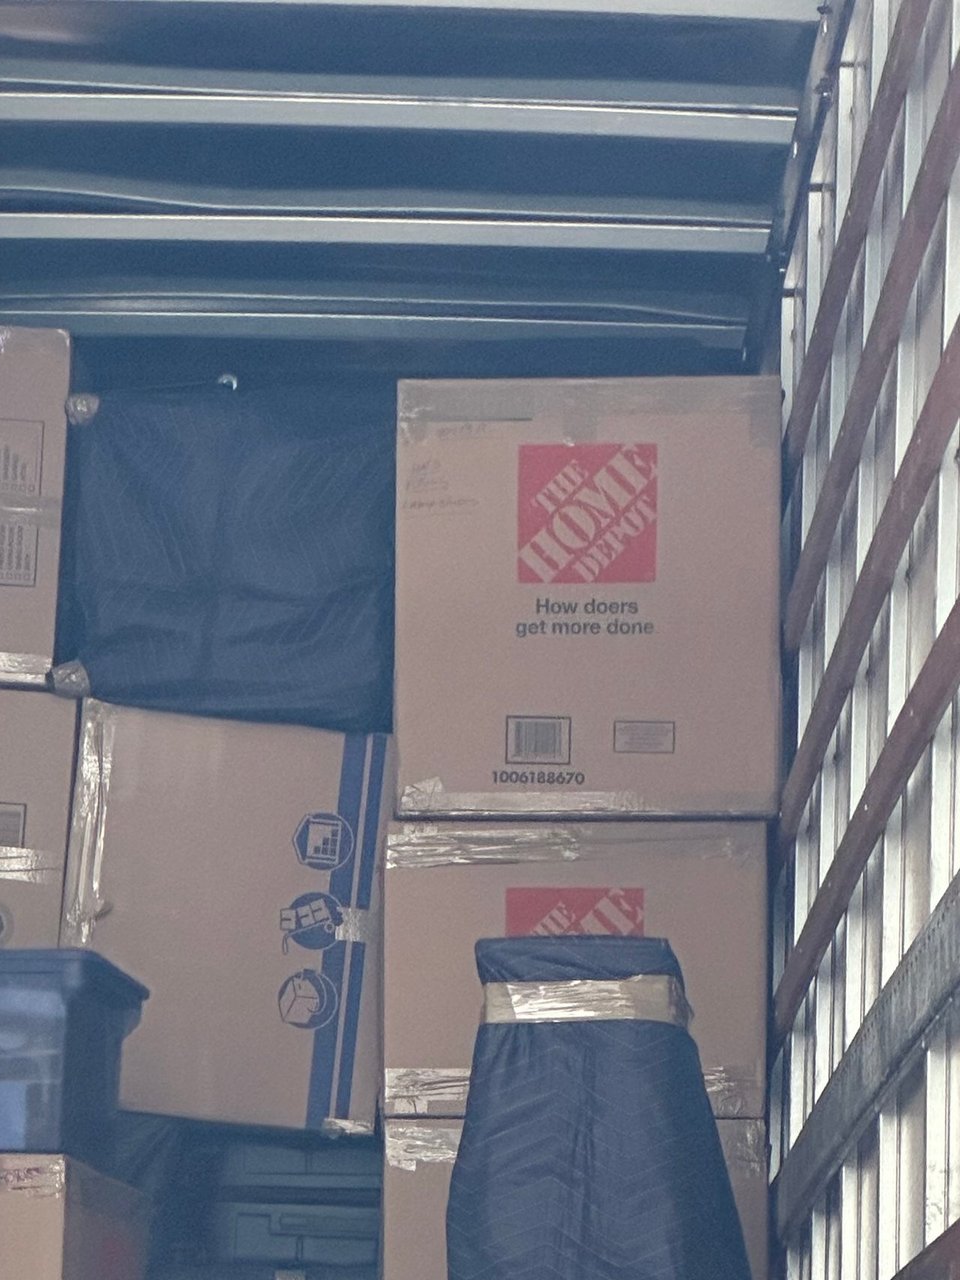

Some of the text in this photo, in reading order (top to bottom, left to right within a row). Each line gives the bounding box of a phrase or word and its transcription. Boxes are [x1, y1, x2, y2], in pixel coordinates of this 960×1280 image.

[531, 459, 589, 514] THE
[518, 444, 657, 584] HOME
[572, 496, 657, 583] DEPOT
[536, 598, 638, 615] How doers
[515, 619, 654, 637] get more done
[492, 770, 585, 785] 1006188670
